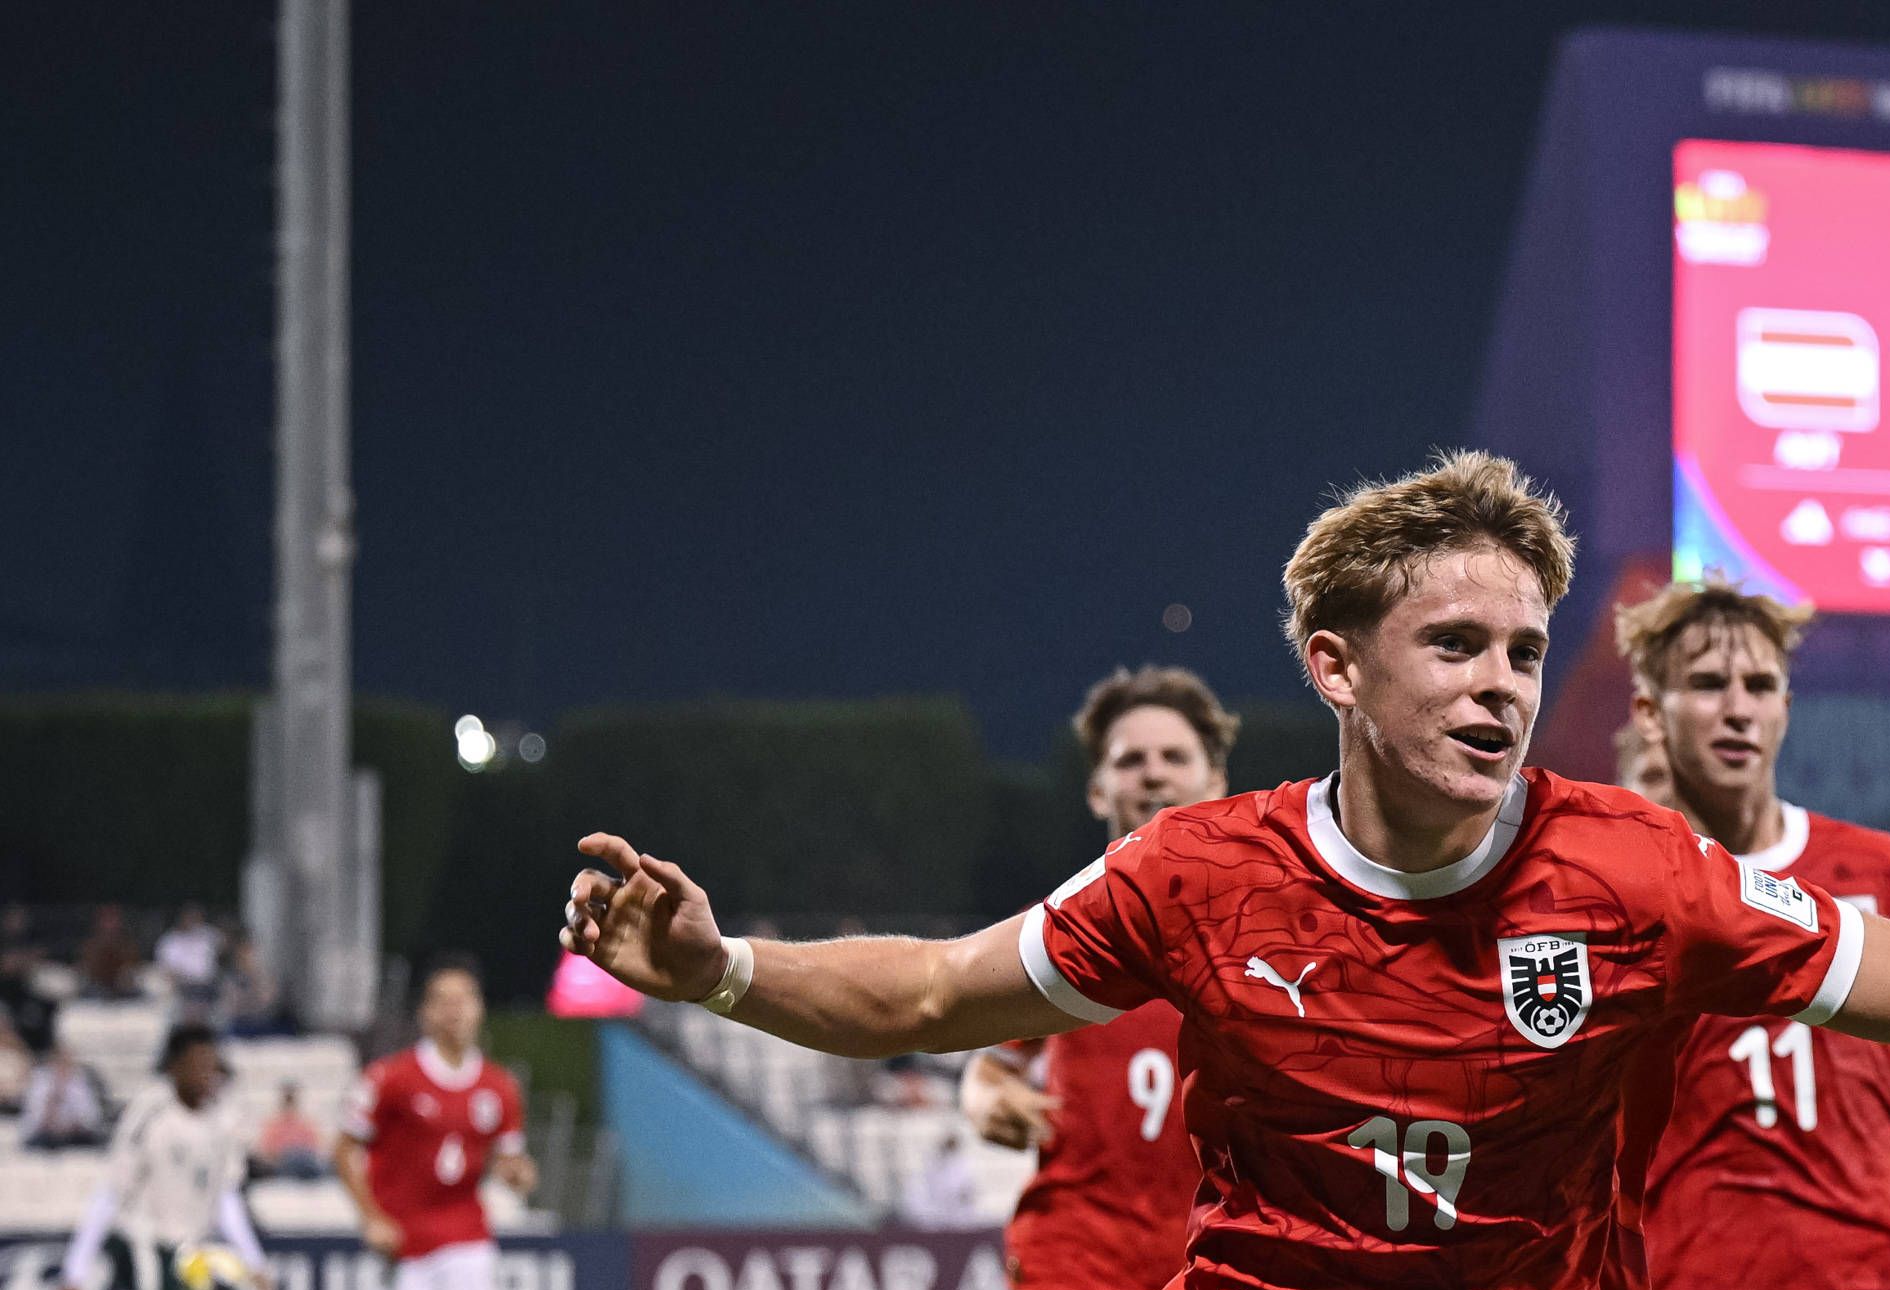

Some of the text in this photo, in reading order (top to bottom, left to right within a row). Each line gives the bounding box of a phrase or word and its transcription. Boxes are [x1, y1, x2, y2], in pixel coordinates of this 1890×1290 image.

[1764, 876, 1778, 898] UNI
[1525, 940, 1561, 953] ÖFB
[1127, 1048, 1174, 1142] 9
[1729, 1025, 1818, 1132] 11
[1348, 1115, 1471, 1232] 19
